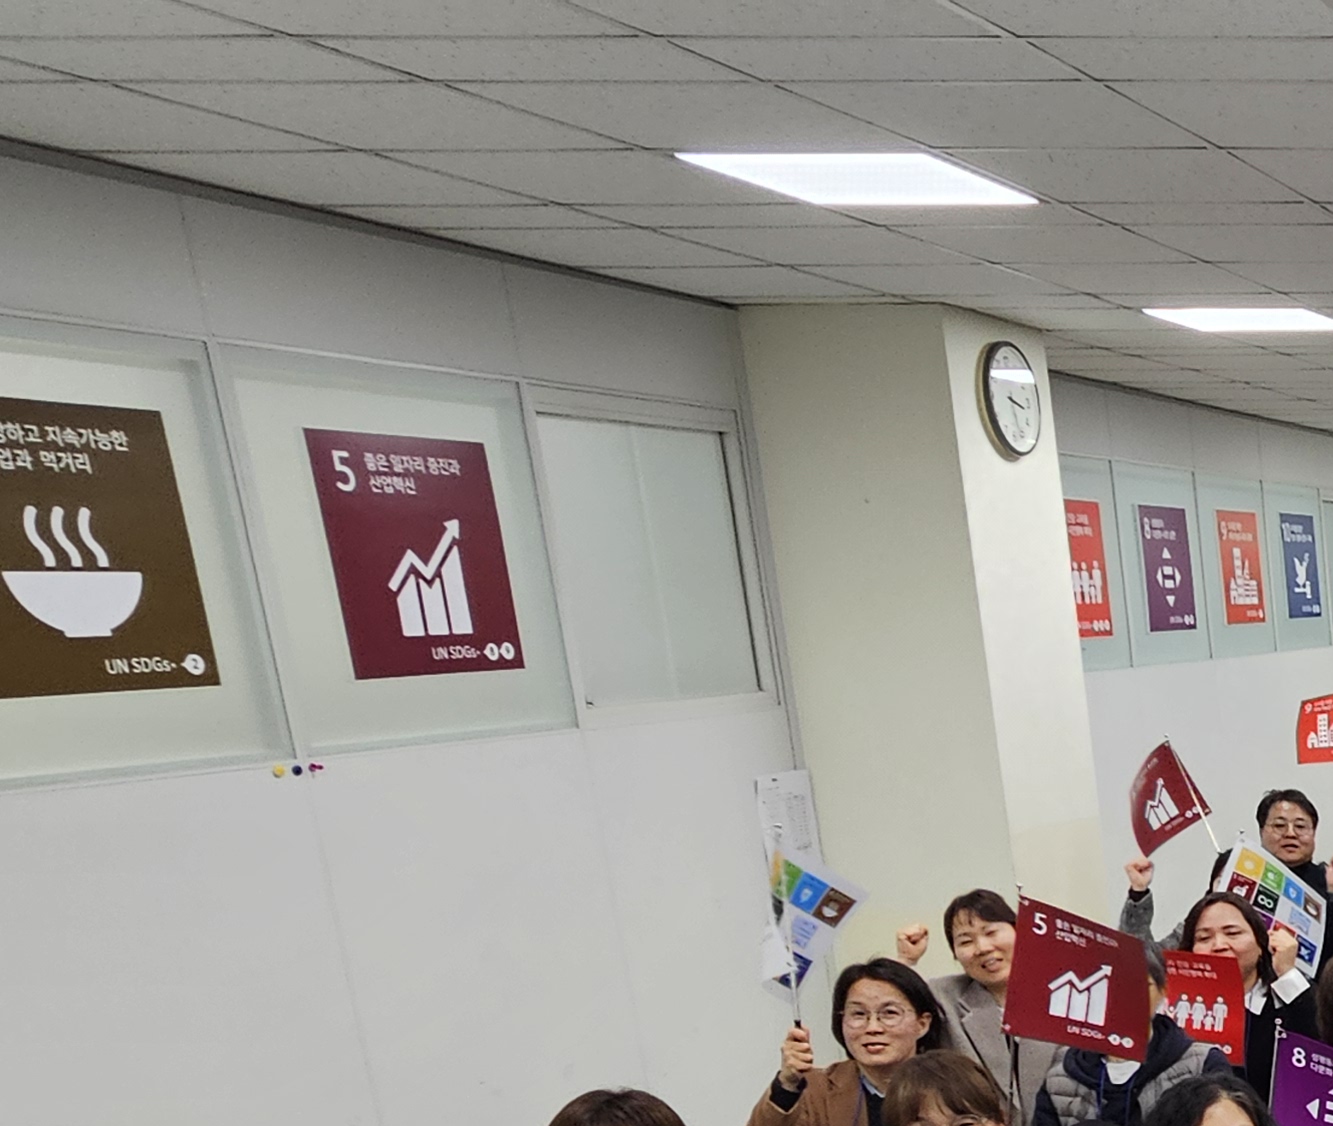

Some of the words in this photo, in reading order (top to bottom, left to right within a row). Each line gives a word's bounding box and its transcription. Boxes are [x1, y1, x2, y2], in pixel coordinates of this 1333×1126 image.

[46, 424, 129, 451] 지속가능한
[40, 451, 92, 475] 먹거리
[331, 450, 356, 492] 5
[431, 646, 449, 660] UN
[105, 658, 129, 674] UN
[1032, 912, 1048, 936] 5
[1067, 1025, 1080, 1035] UN
[1292, 1047, 1306, 1068] 8
